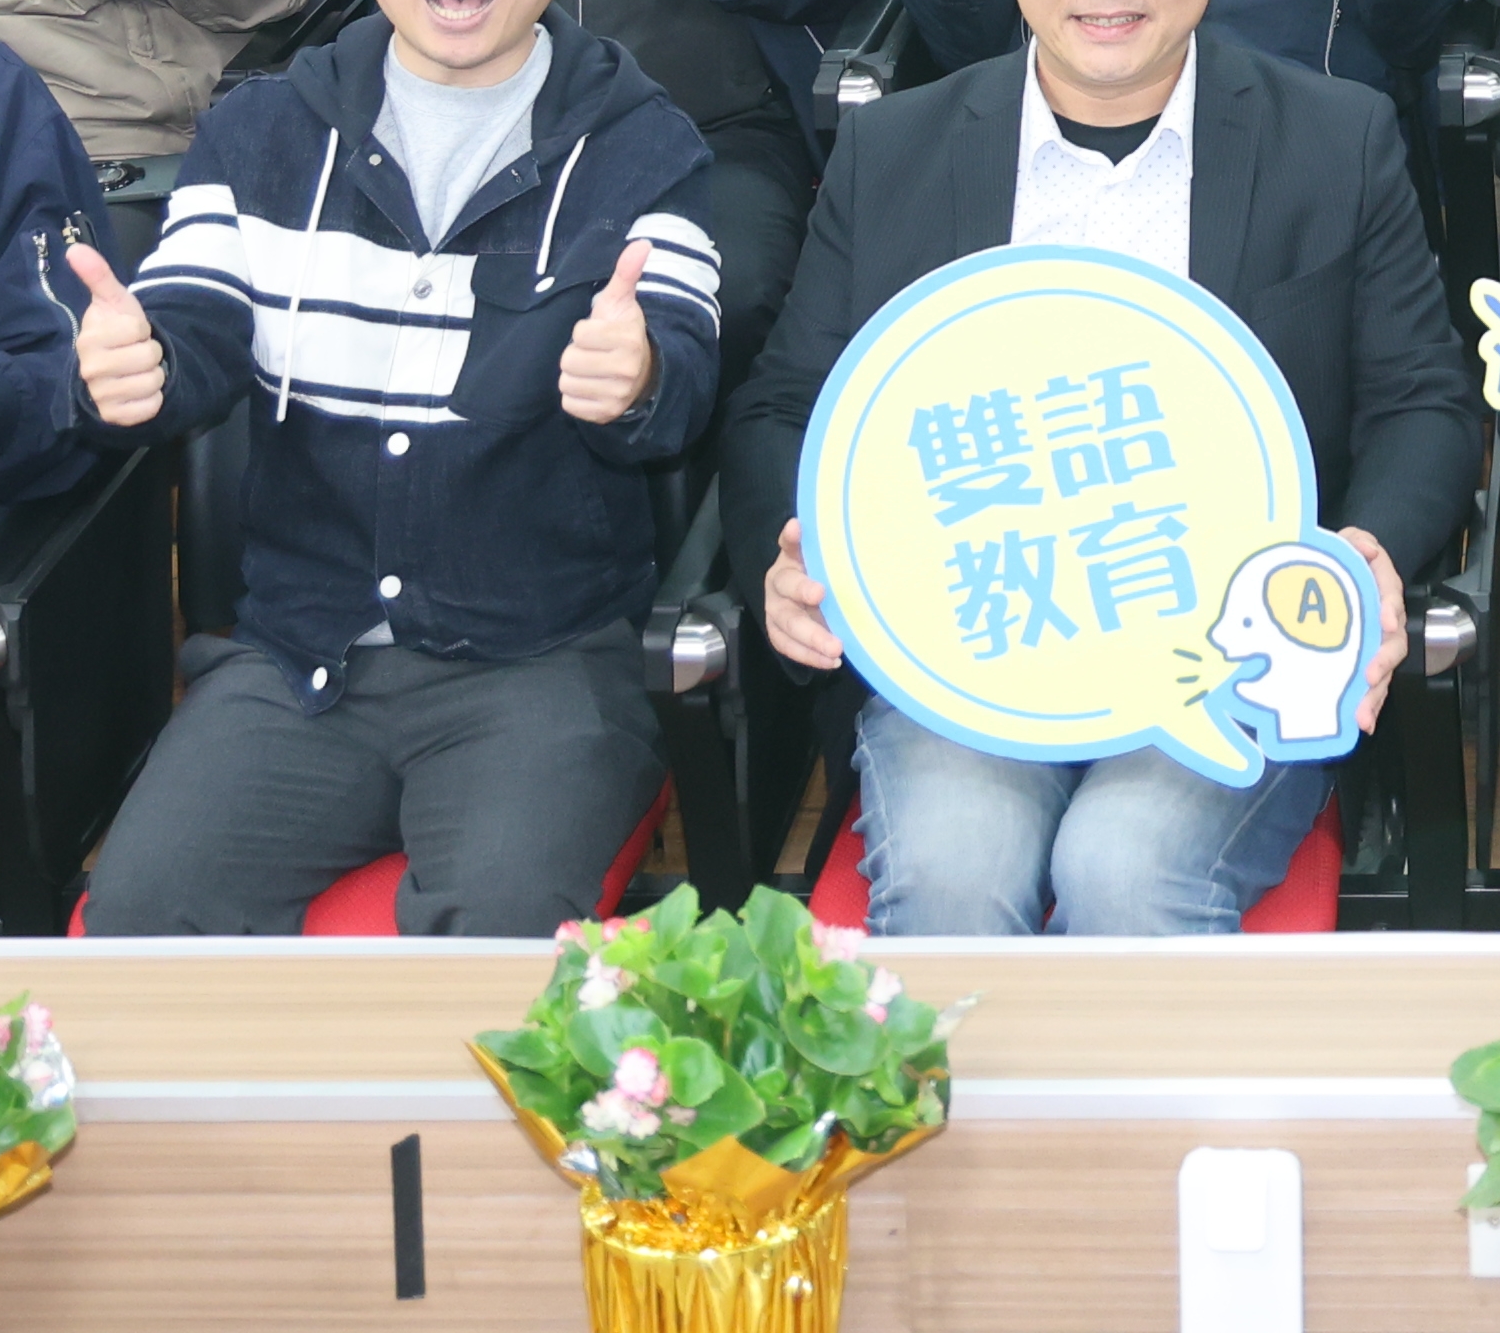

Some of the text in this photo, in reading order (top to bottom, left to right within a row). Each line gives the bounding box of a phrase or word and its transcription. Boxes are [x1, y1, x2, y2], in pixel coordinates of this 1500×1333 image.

[907, 361, 1176, 528] 雙語
[944, 502, 1197, 661] 教育
[1298, 577, 1327, 625] A
